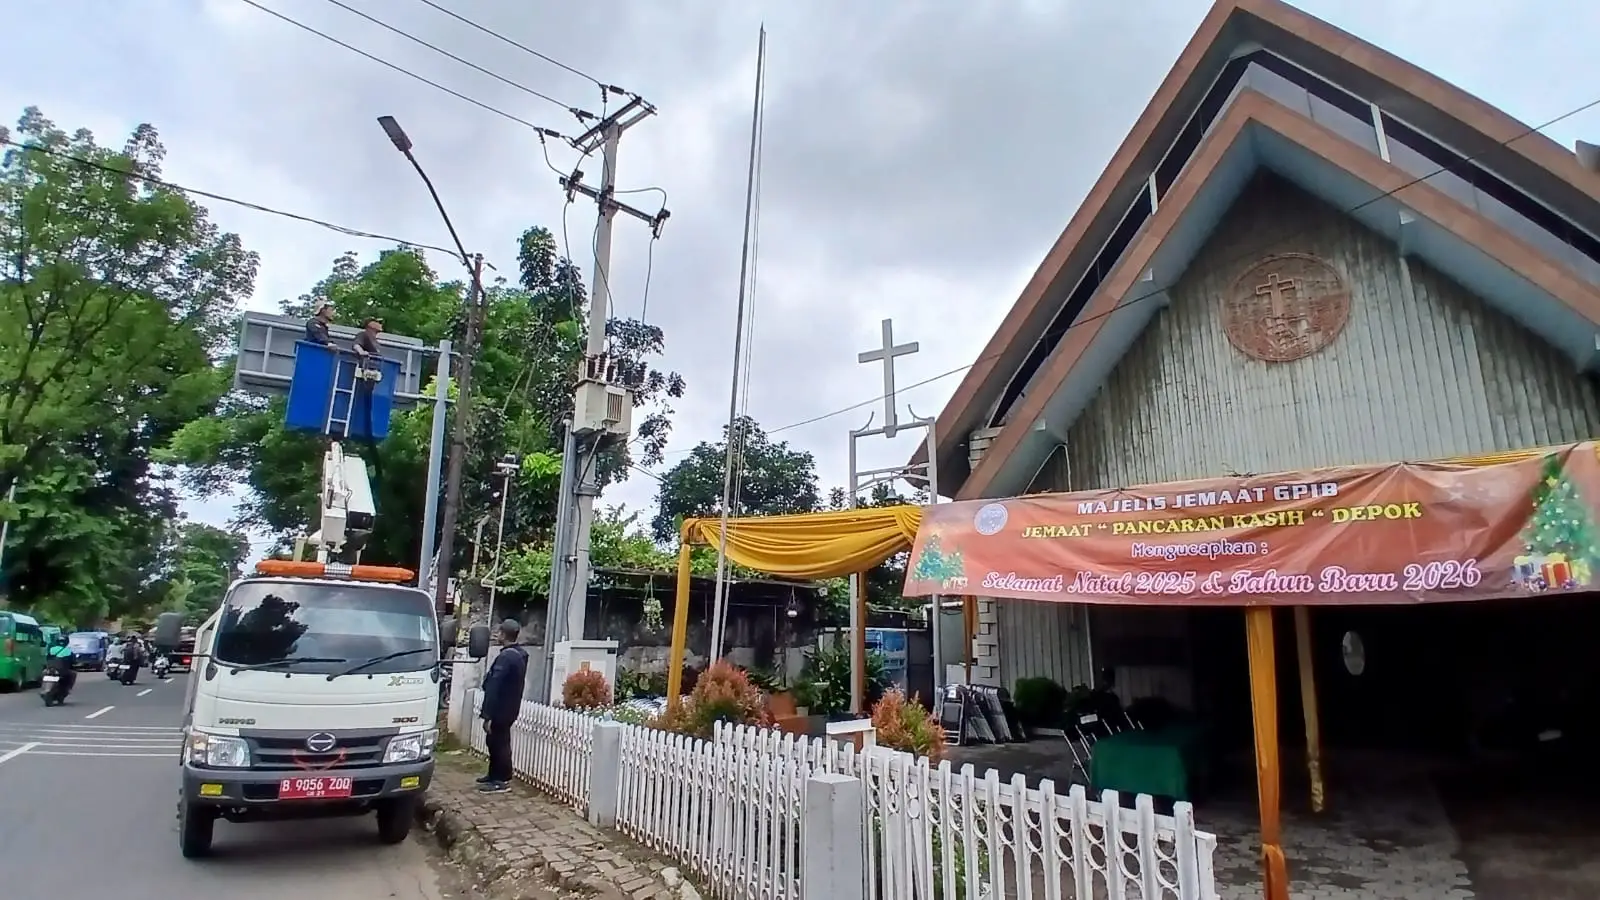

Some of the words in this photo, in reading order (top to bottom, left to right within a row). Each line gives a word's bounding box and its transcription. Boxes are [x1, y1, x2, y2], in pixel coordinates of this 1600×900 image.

[1077, 496, 1166, 515] MAJELIS
[1172, 487, 1266, 508] JEMAAT
[1273, 482, 1338, 501] GPIB
[1022, 524, 1092, 538] JEMAAT
[1112, 516, 1225, 535] PANCARAN
[1232, 510, 1304, 529] KASIH
[1331, 502, 1422, 524] DEPOK
[1131, 539, 1255, 562] Mengucapkan
[982, 571, 1063, 593] Selamat
[1067, 571, 1131, 594] Natal
[1135, 571, 1196, 594] 2025
[1200, 573, 1224, 594] &
[1229, 568, 1314, 594] Tahun
[1318, 565, 1398, 593] Baru
[1403, 559, 1481, 591] 2026
[281, 779, 290, 792] B
[295, 779, 324, 792] 9056
